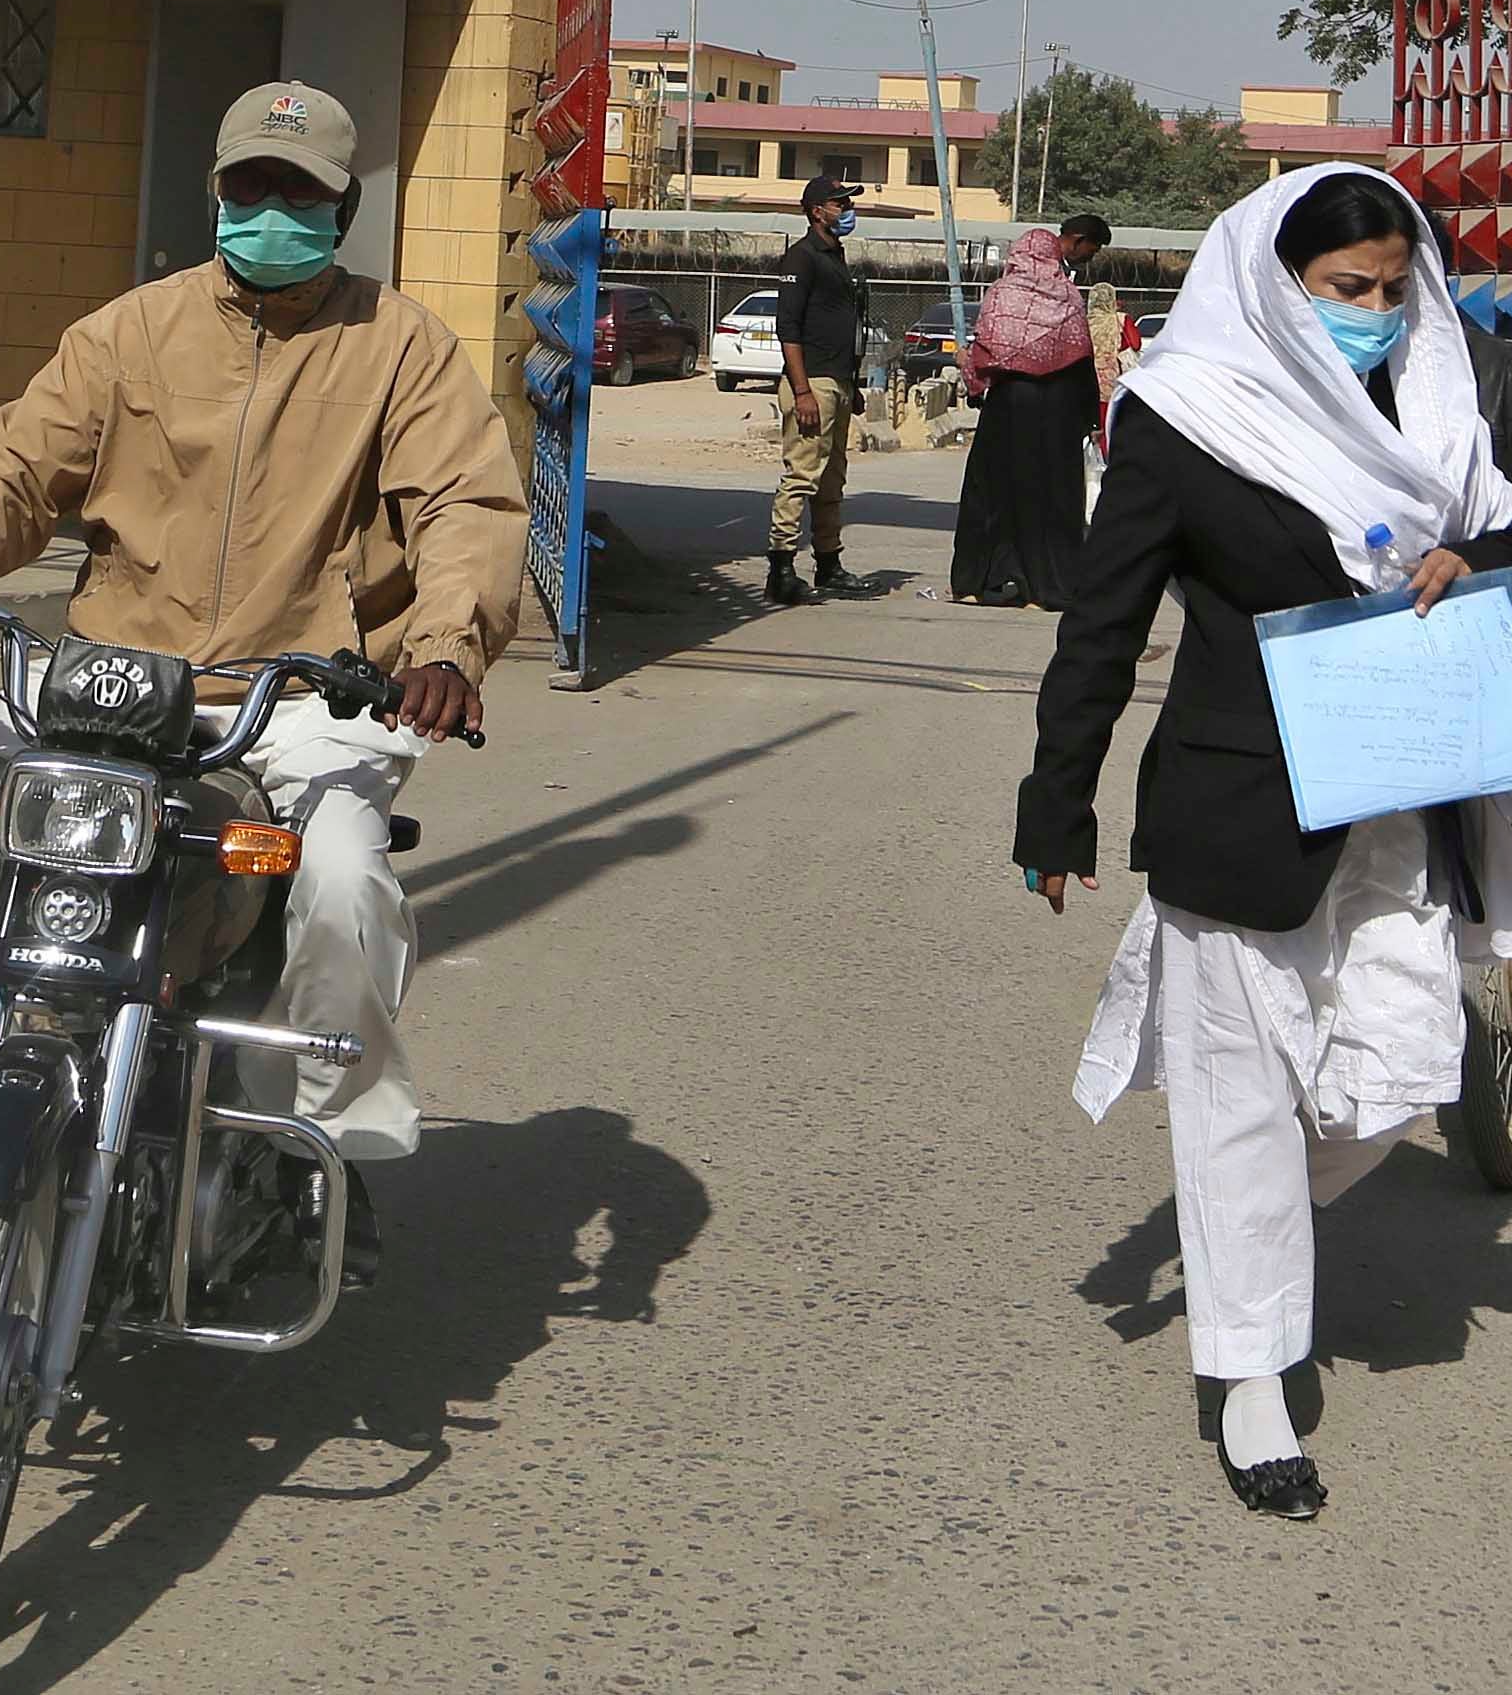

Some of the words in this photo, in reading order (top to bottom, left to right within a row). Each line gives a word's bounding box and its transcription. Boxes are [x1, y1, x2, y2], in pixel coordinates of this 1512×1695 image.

[268, 112, 308, 127] NBC
[71, 658, 153, 698] HONDA
[8, 947, 105, 973] HONDA
